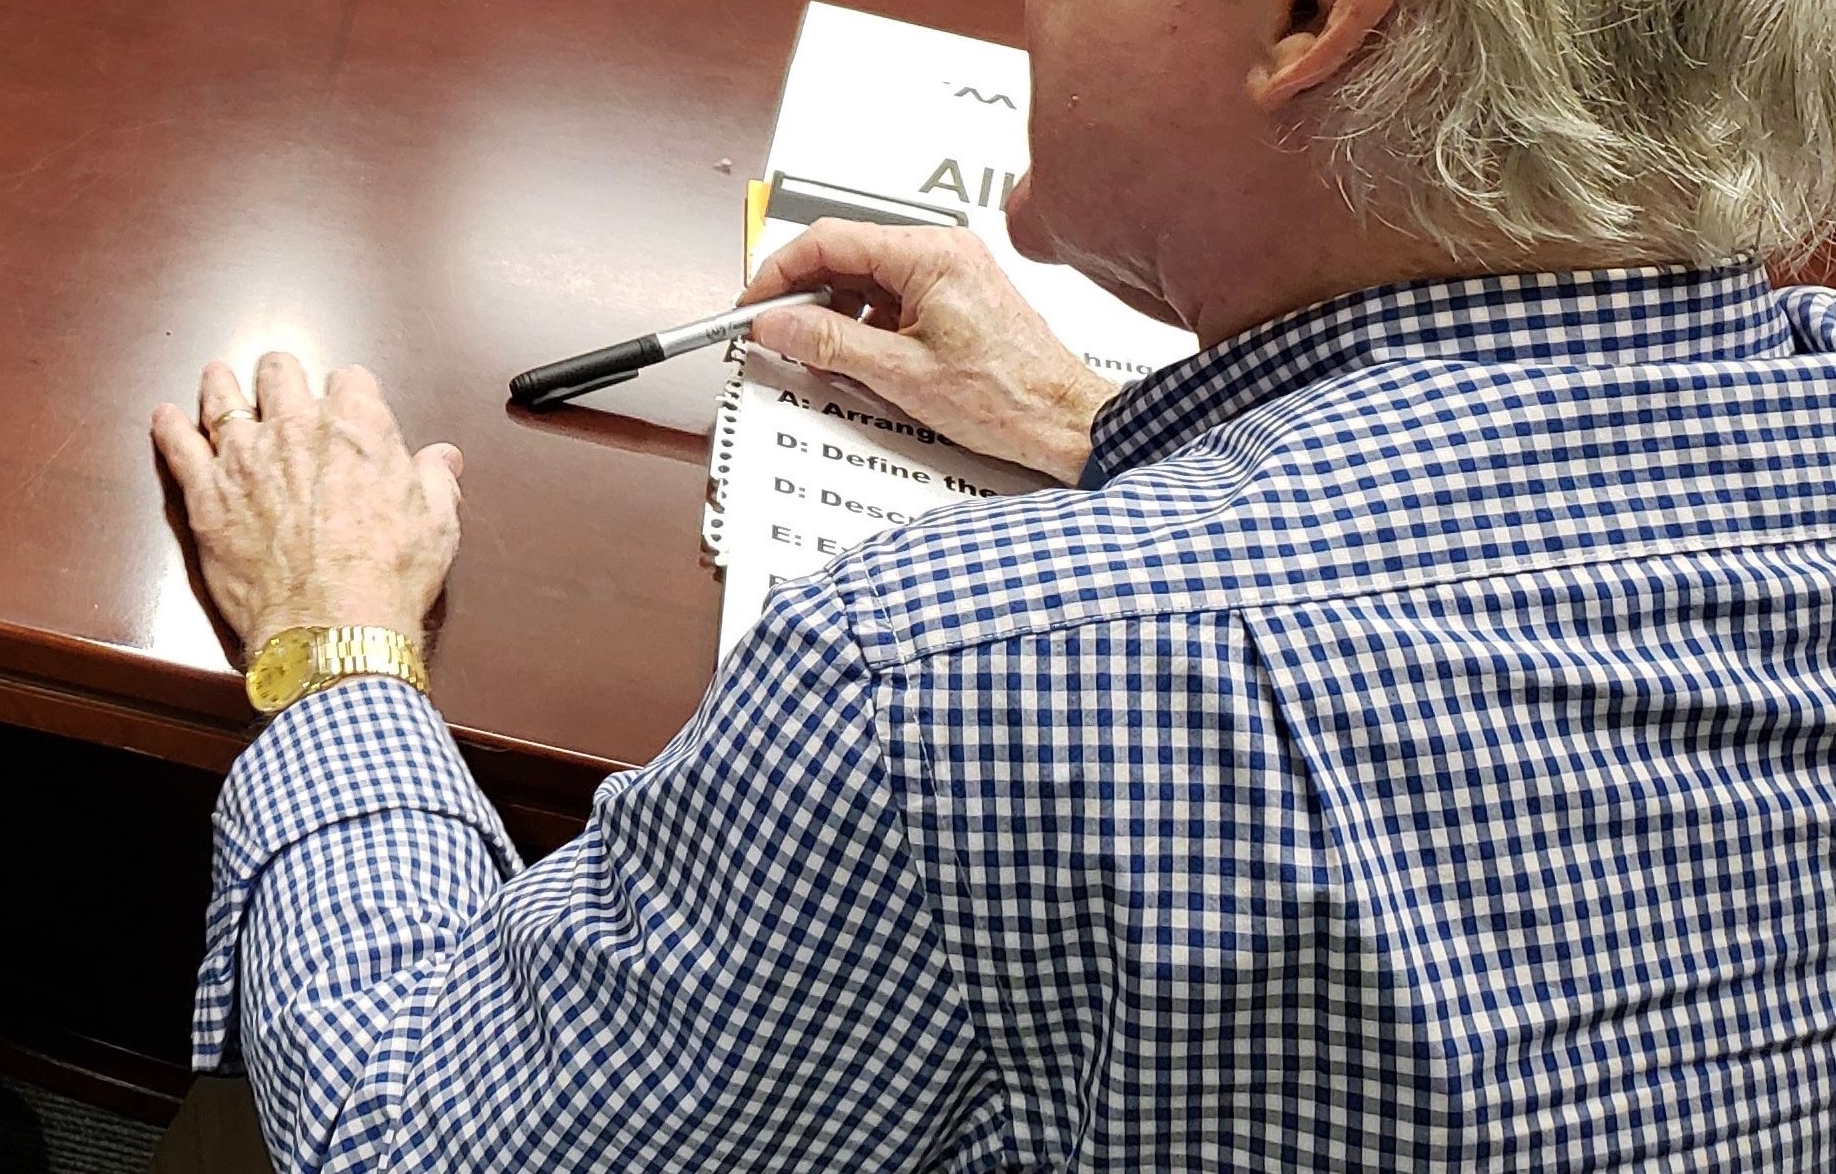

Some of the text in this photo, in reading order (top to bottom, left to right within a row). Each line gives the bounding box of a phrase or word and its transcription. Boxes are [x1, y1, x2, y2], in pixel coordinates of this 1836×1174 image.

[777, 389, 957, 446] A: Arrange
[776, 431, 998, 499] D: Define the
[774, 476, 806, 499] D:
[771, 523, 802, 547] E:
